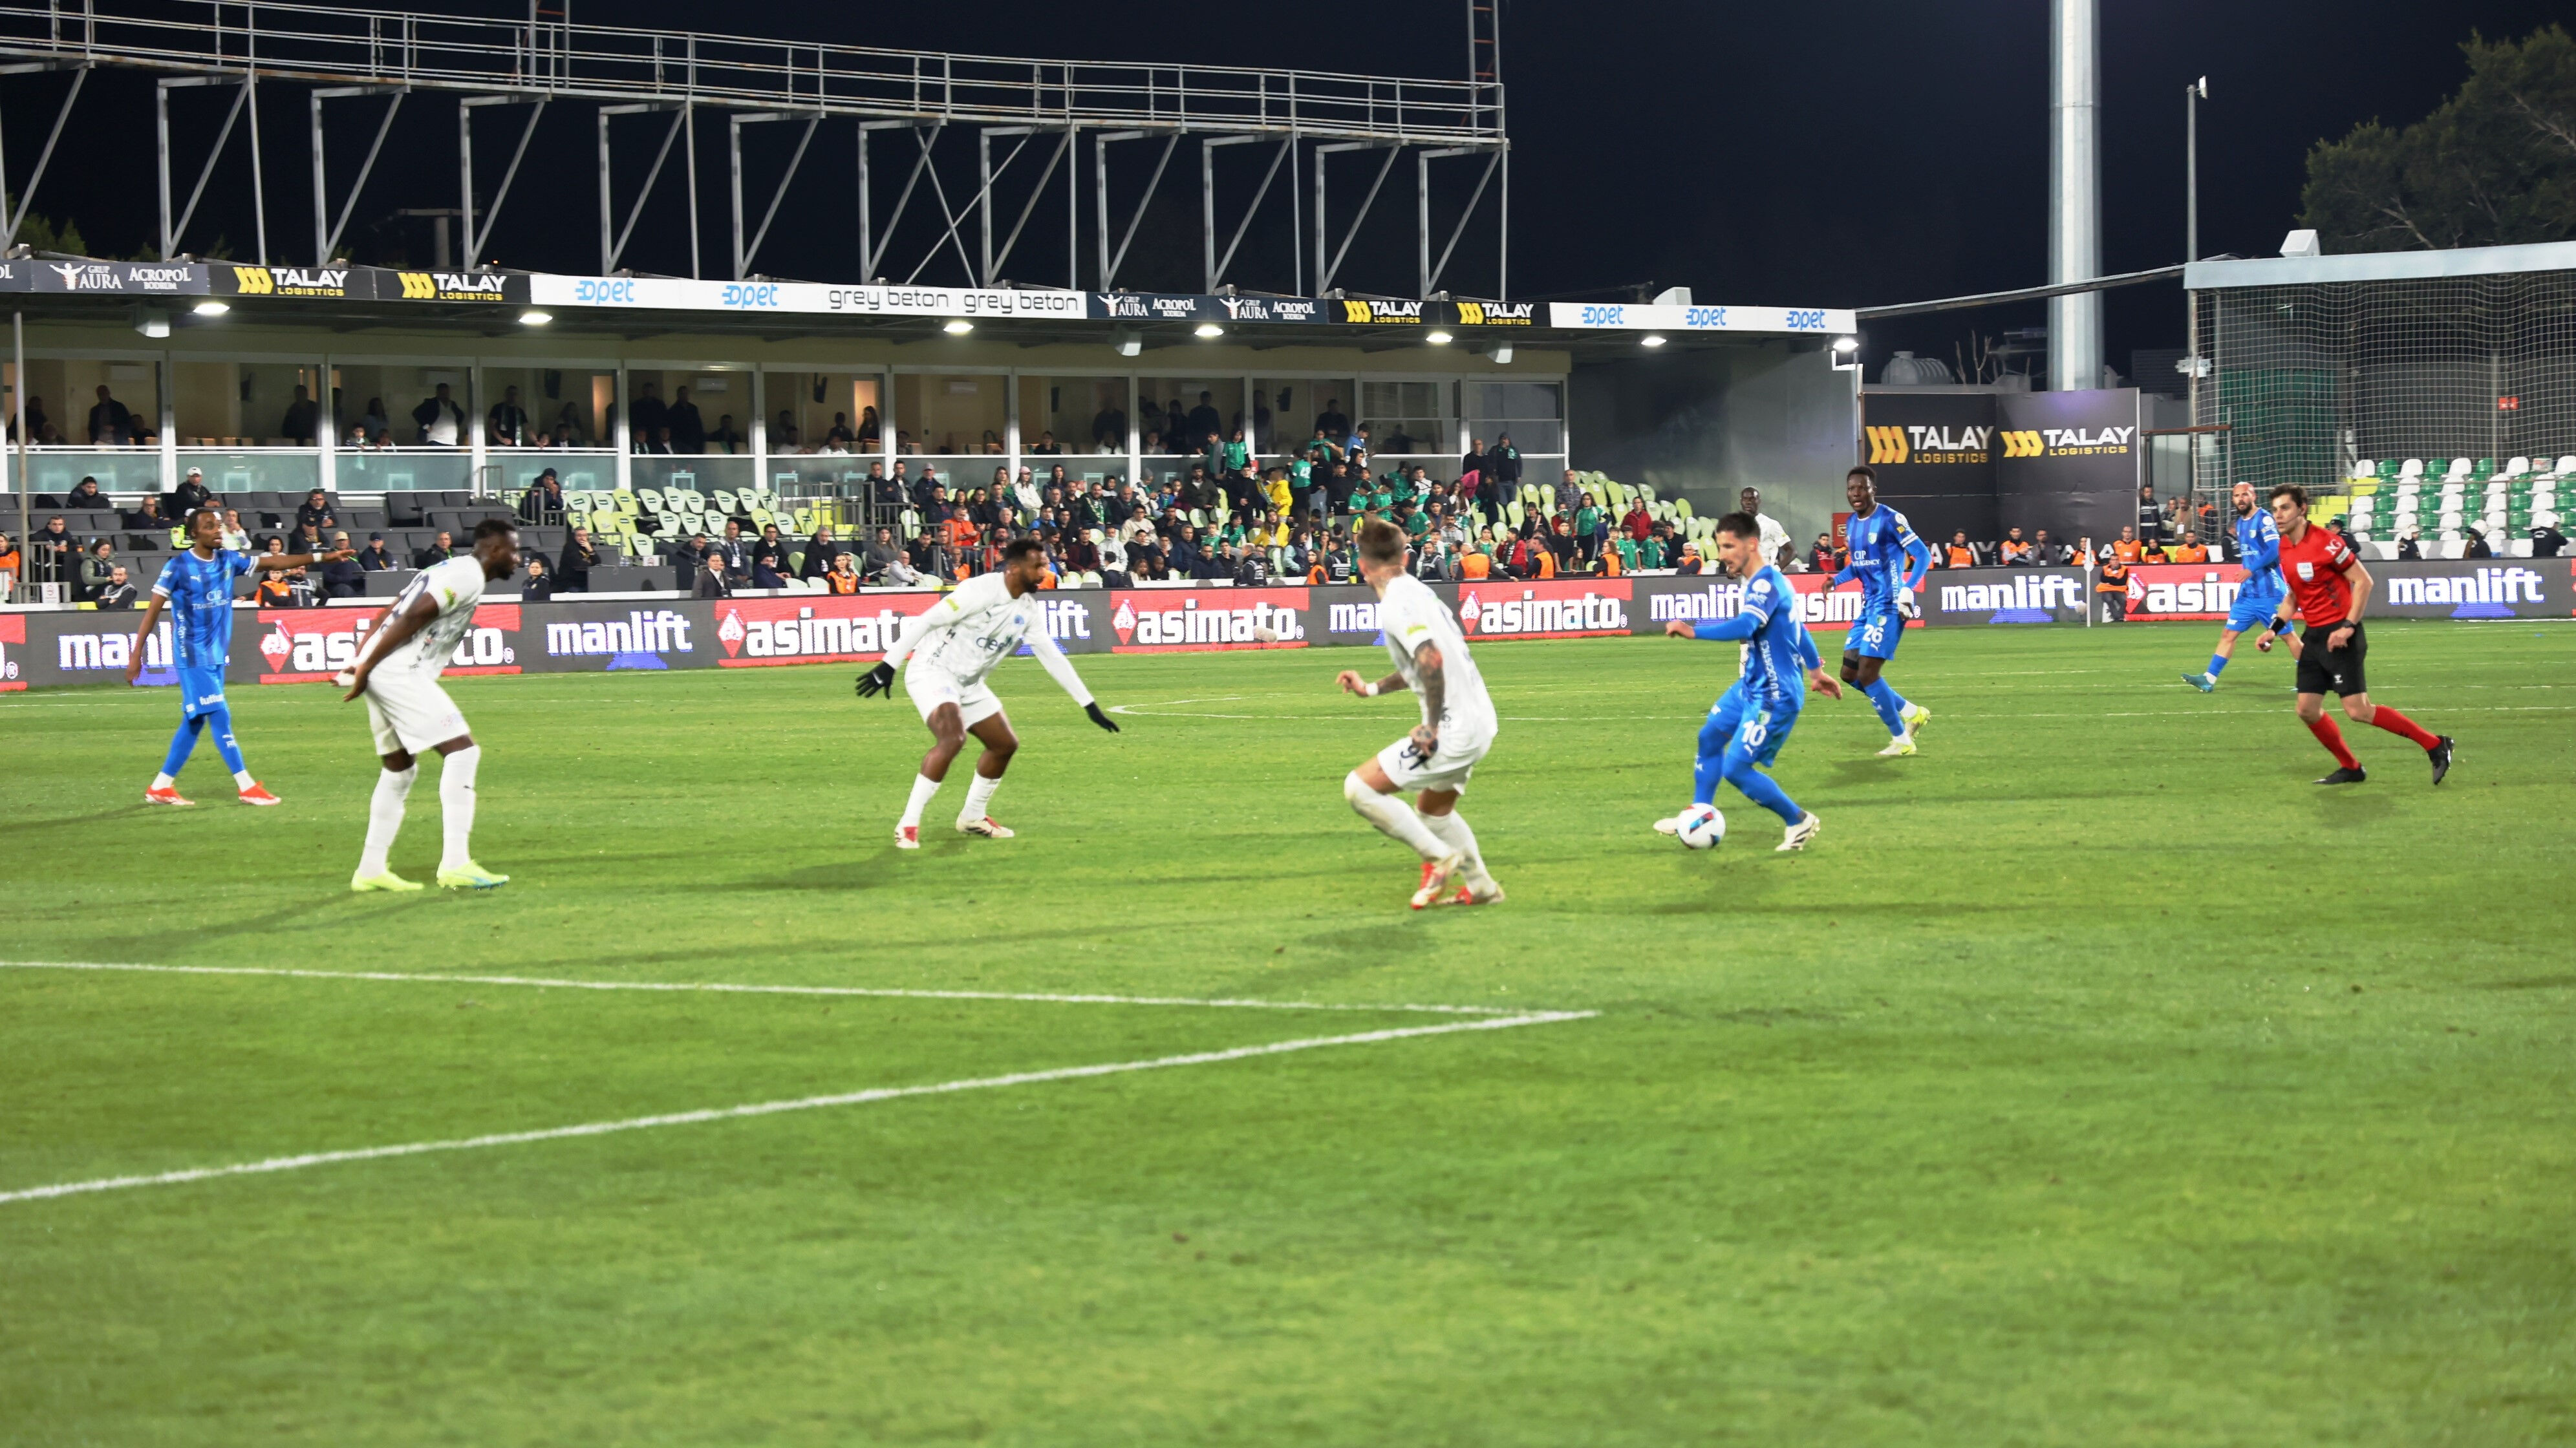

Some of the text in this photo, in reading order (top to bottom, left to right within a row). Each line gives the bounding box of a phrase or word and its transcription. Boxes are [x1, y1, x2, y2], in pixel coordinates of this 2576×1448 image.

[79, 273, 123, 289] AURA
[128, 267, 191, 282] ACROPOL
[271, 269, 349, 287] TALAY
[433, 274, 507, 292] TALAY
[277, 287, 345, 297] LOGISTICS
[439, 292, 502, 301] LOGISTICS
[829, 288, 949, 310] grey beton
[964, 292, 1079, 314] grey beton
[1117, 303, 1149, 316] AURA
[1152, 297, 1196, 310] ACROPOL
[1272, 301, 1315, 314] ACROPOL
[1369, 301, 1423, 315] TALAY
[1482, 303, 1534, 317] TALAY
[1239, 306, 1269, 319] AURA
[1908, 426, 1994, 450] TALAY
[2043, 426, 2135, 447] TALAY
[1914, 453, 1988, 463] LOGISTICS
[2049, 445, 2128, 456] LOGISTICS
[1941, 575, 2084, 612] manlift
[2388, 567, 2545, 605] manlift
[546, 610, 693, 655] manlift
[1862, 624, 1884, 643] 26
[1741, 719, 1766, 746] 10
